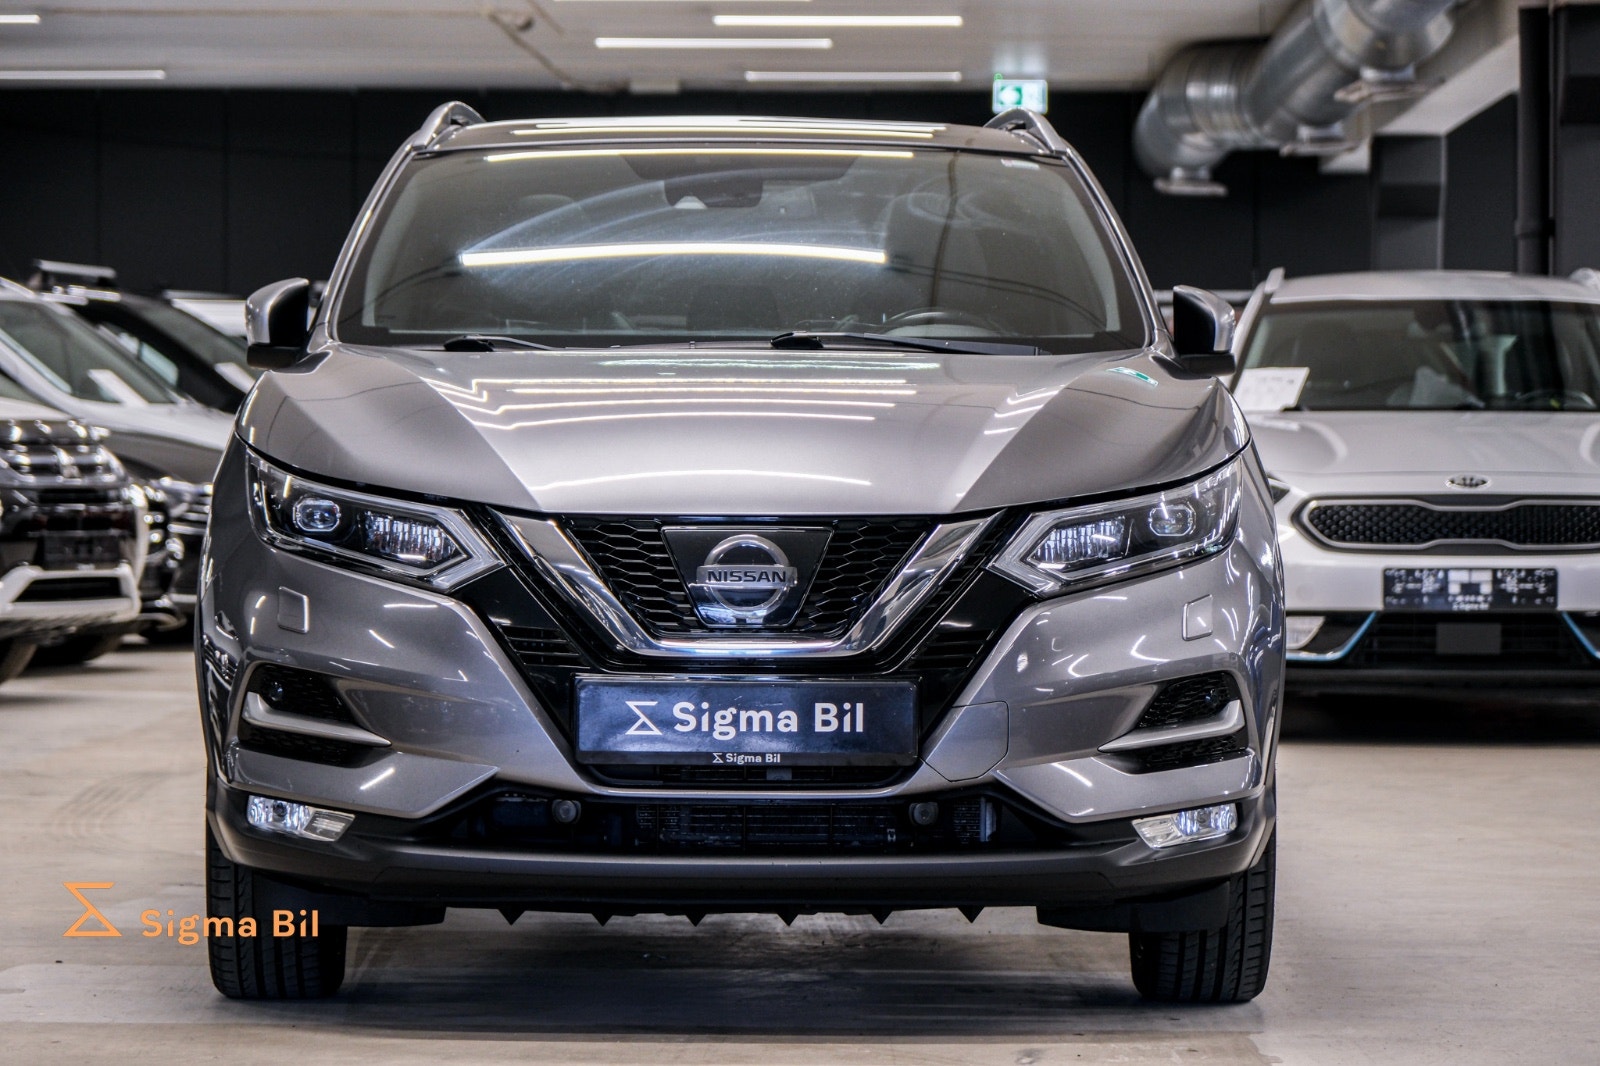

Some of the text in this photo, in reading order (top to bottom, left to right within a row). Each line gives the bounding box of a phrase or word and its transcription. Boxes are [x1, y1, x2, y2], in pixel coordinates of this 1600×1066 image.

[707, 570, 787, 583] NISSAN
[672, 701, 864, 741] Sigma Bil
[725, 753, 781, 765] Sigma Bil
